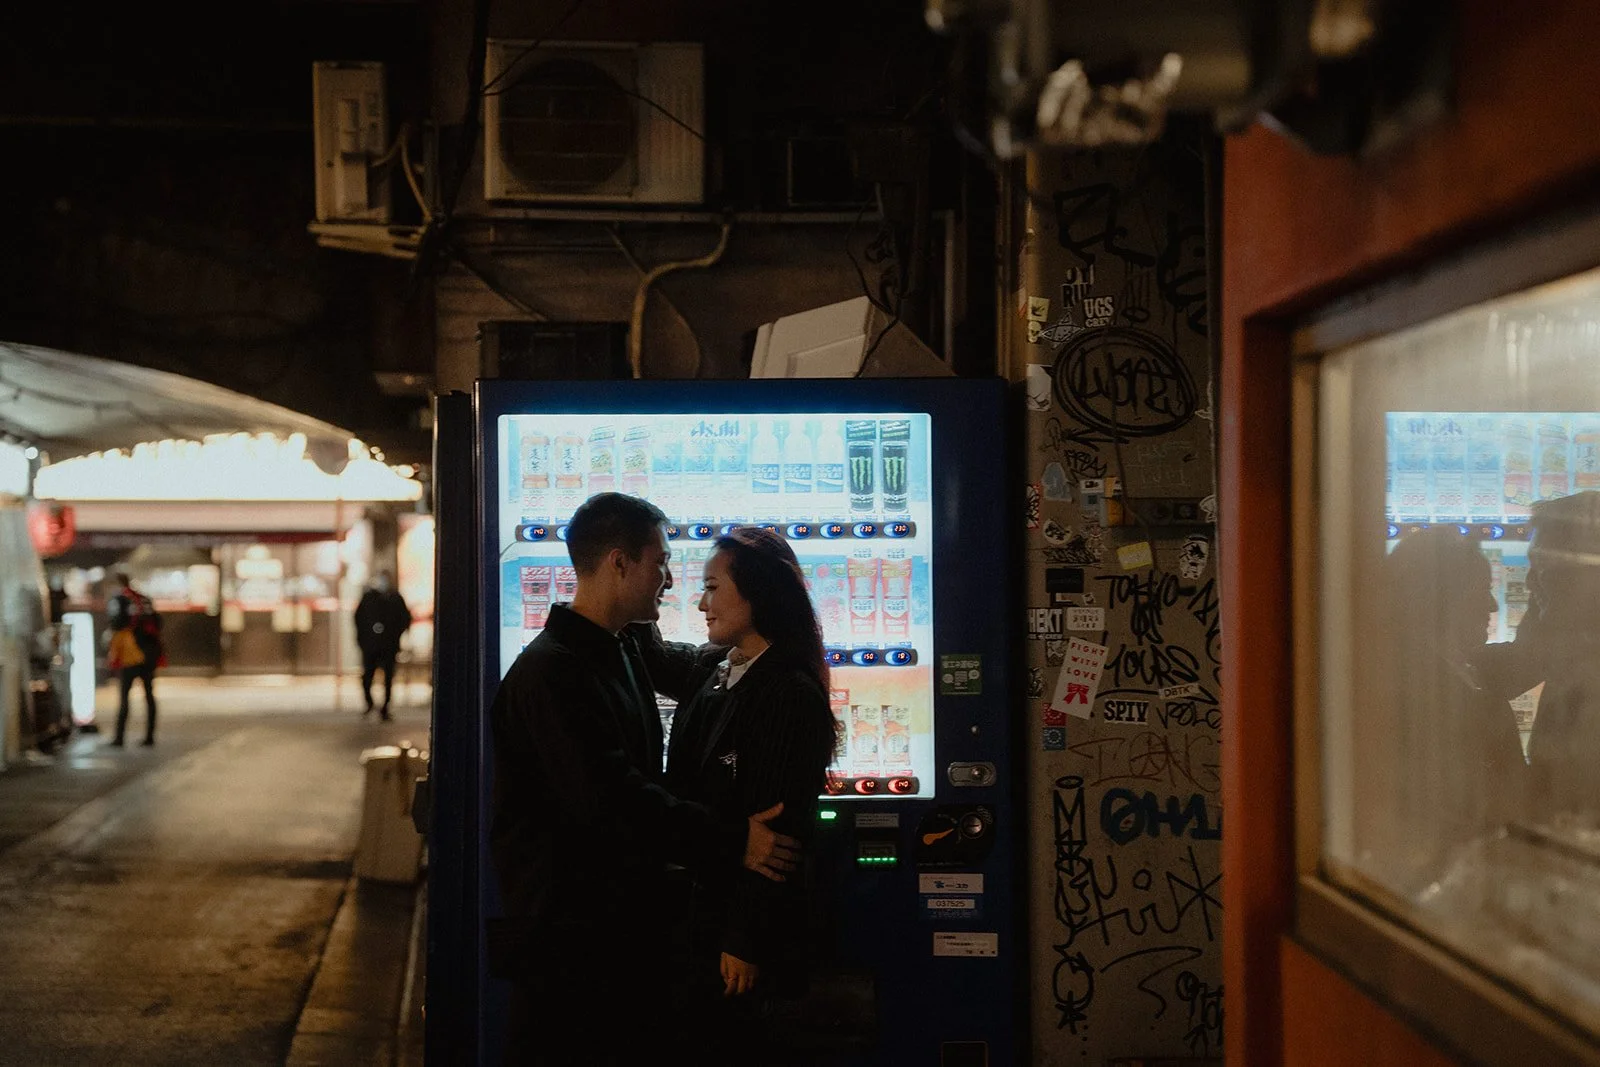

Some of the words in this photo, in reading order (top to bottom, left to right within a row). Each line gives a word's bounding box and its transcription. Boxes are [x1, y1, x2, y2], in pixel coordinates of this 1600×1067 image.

[1084, 296, 1114, 318] UGS
[1071, 642, 1105, 656] FIGHT
[1071, 656, 1099, 667] WITH
[1104, 644, 1200, 687] YOURS
[1067, 667, 1097, 680] LOVE
[935, 900, 966, 908] 037525
